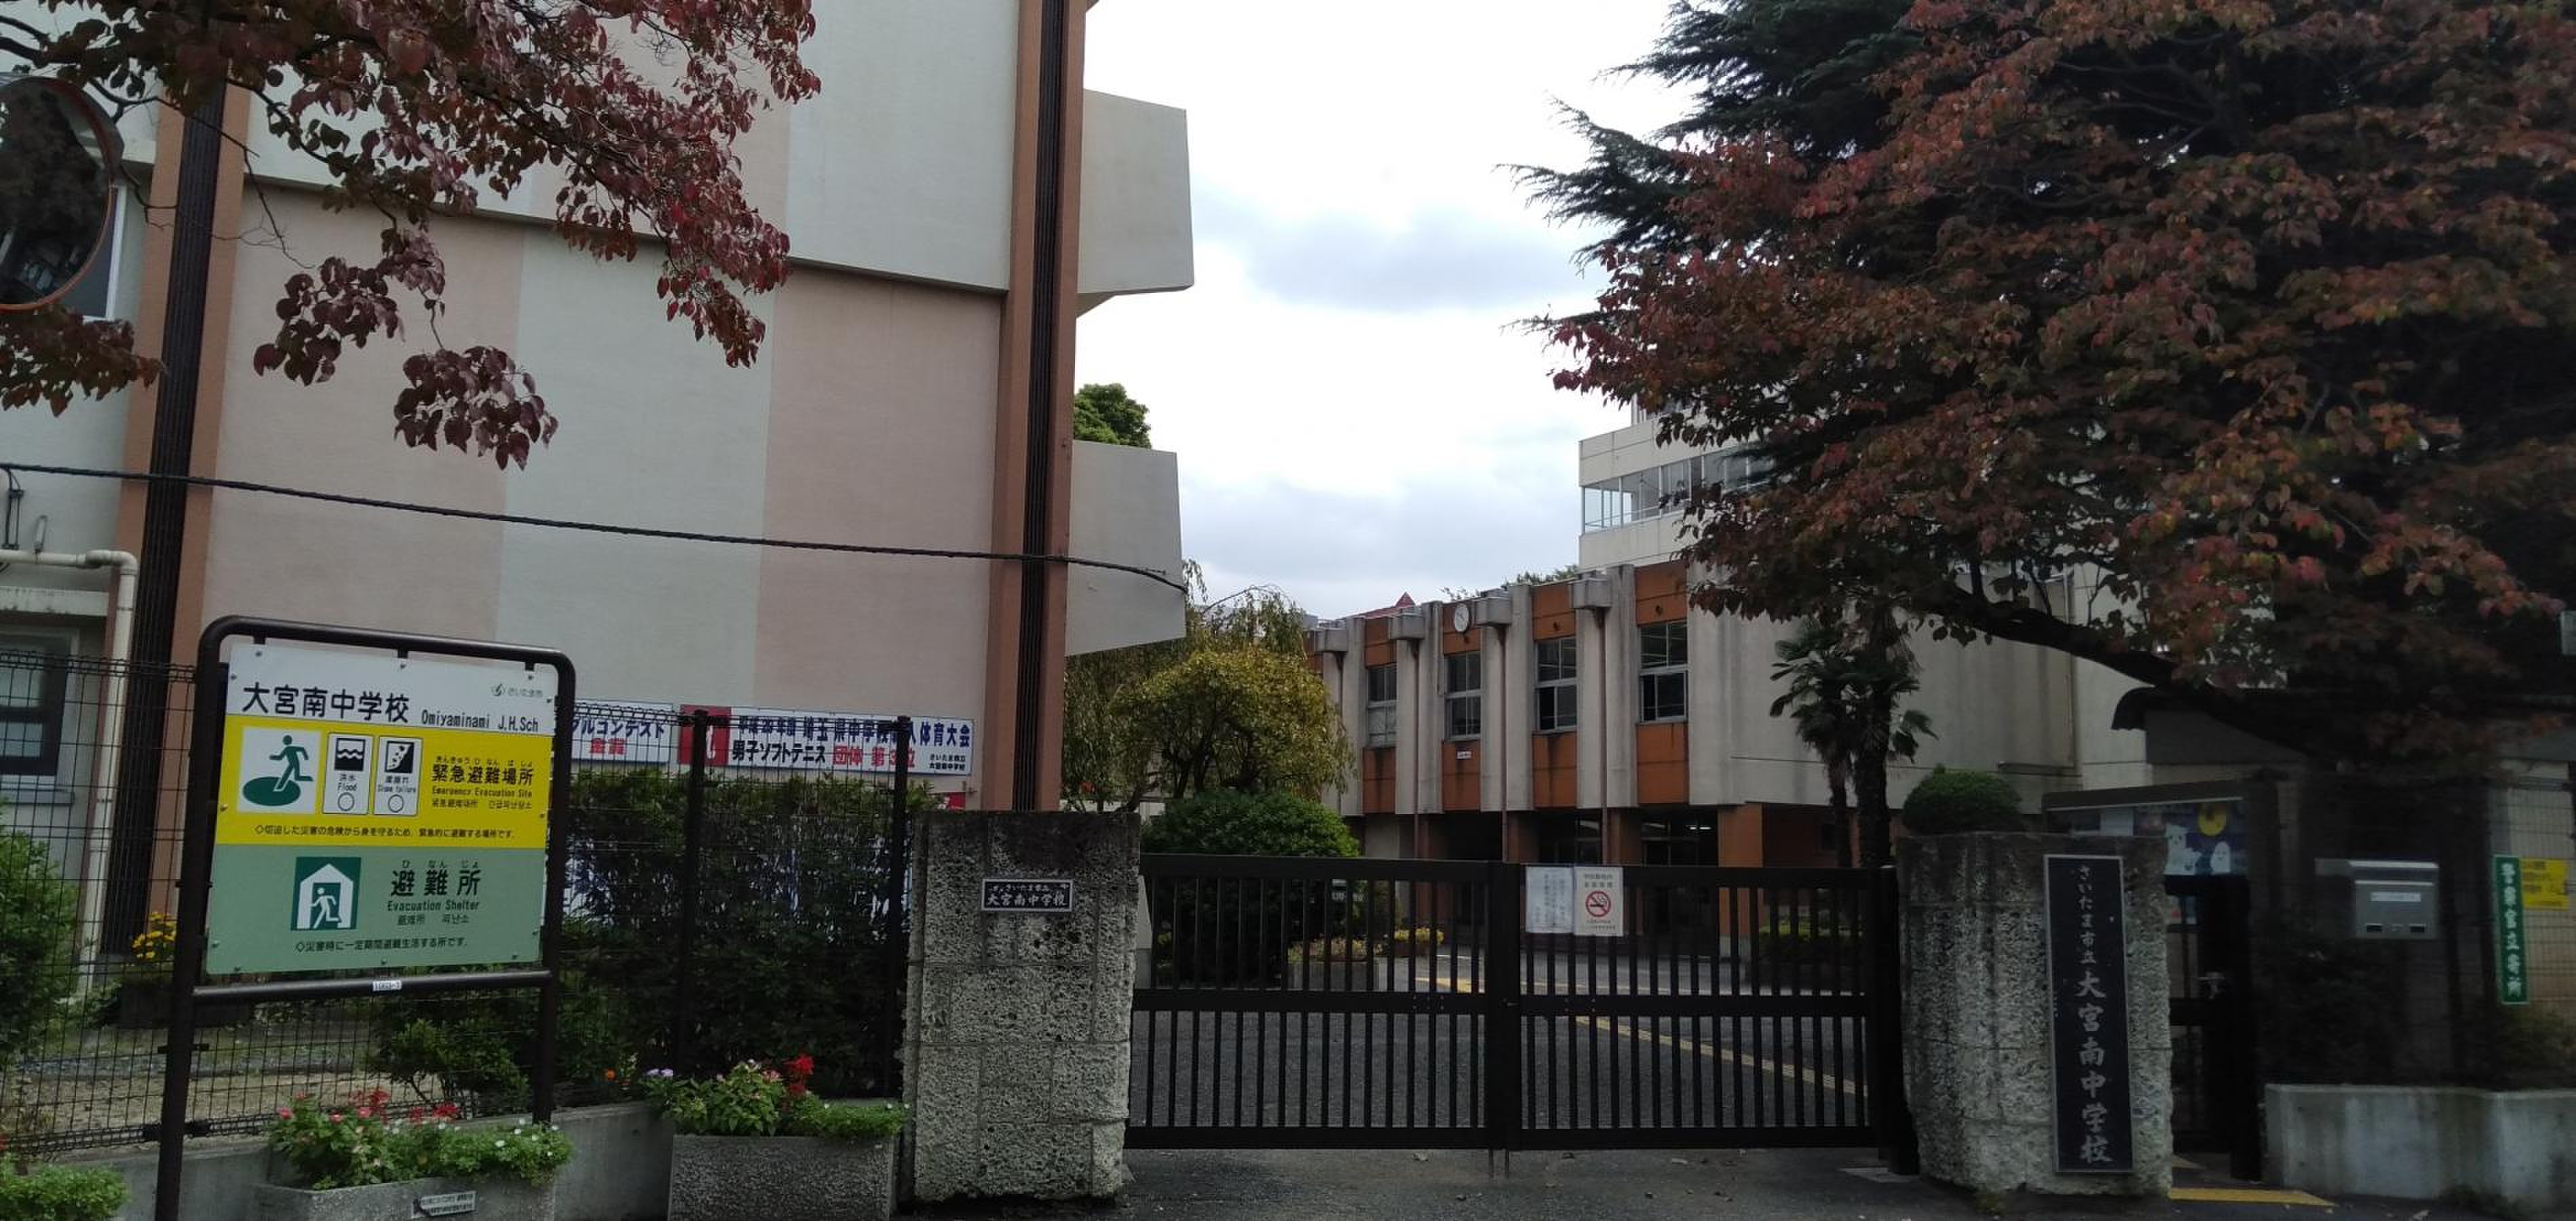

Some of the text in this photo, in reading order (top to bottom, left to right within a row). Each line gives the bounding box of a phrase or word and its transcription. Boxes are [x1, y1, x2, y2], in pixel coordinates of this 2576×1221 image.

[242, 681, 411, 724] 大宮南中学校
[421, 709, 539, 732] Omiyaminami J.H.Sch
[732, 740, 826, 764] 男子ソフトテニス
[432, 764, 534, 786] 緊急避難場所
[338, 781, 358, 792] Flood
[390, 869, 481, 896] 避難所
[387, 899, 480, 912] Evacuation Shelter
[987, 890, 1068, 906] 大宮南中学校
